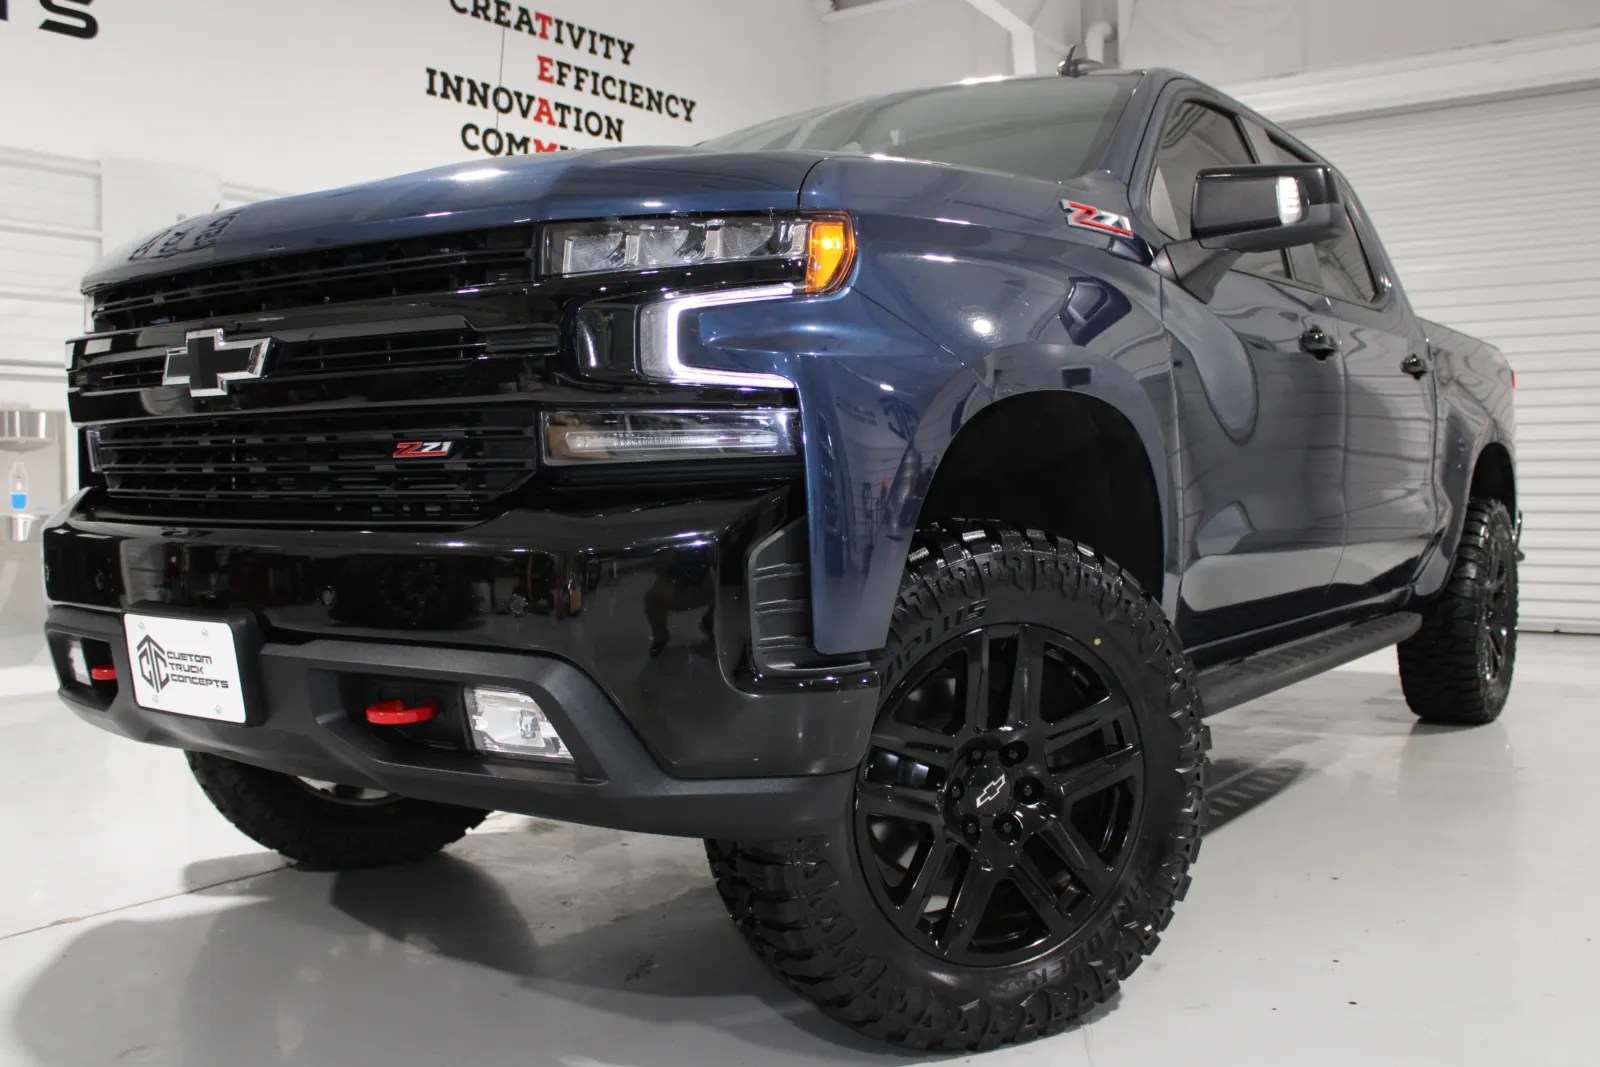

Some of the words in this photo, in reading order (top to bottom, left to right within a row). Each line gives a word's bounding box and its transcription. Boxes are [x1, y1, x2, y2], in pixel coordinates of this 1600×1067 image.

[537, 55, 696, 122] EFFICIENCY
[425, 67, 624, 142] INNOVATION
[461, 123, 578, 157] COMM
[1060, 199, 1134, 239] Z71
[393, 441, 452, 458] Z71
[166, 650, 213, 665] CUSTOM
[168, 661, 205, 675] TRUCK
[170, 673, 229, 689] CONCEPTS
